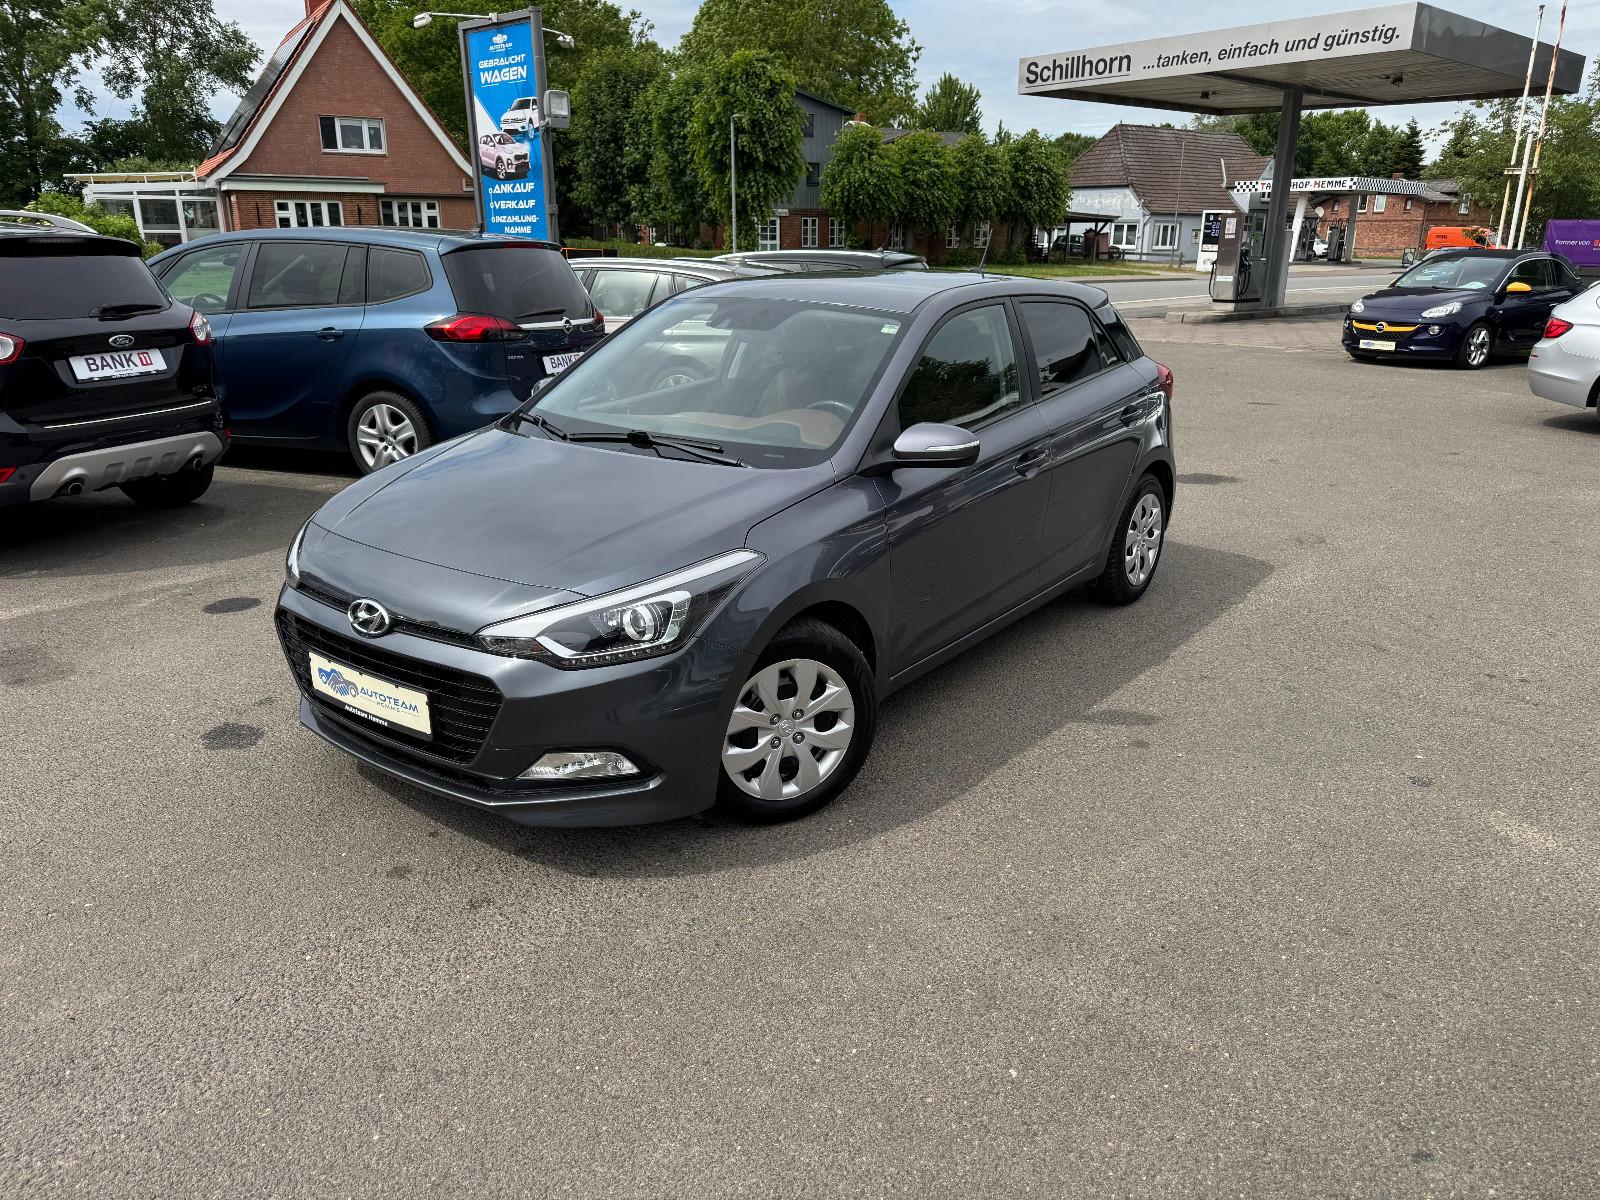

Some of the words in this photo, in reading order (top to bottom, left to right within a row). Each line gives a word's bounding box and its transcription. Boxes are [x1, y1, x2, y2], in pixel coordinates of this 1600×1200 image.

[478, 53, 526, 69] GEBRAUCHT
[1025, 53, 1132, 85] Schillhorn
[1217, 38, 1279, 61] einfach
[1284, 32, 1321, 53] und
[1323, 23, 1401, 52] günstig.
[480, 65, 527, 84] WAGEN
[493, 182, 535, 194] ANKAUF
[494, 200, 536, 209] VERKAUF
[495, 215, 540, 223] INZAHLUNG-
[504, 225, 532, 234] NAHME
[85, 353, 137, 372] BANK
[549, 354, 574, 369] BANK
[359, 685, 420, 714] AUTOTEAM
